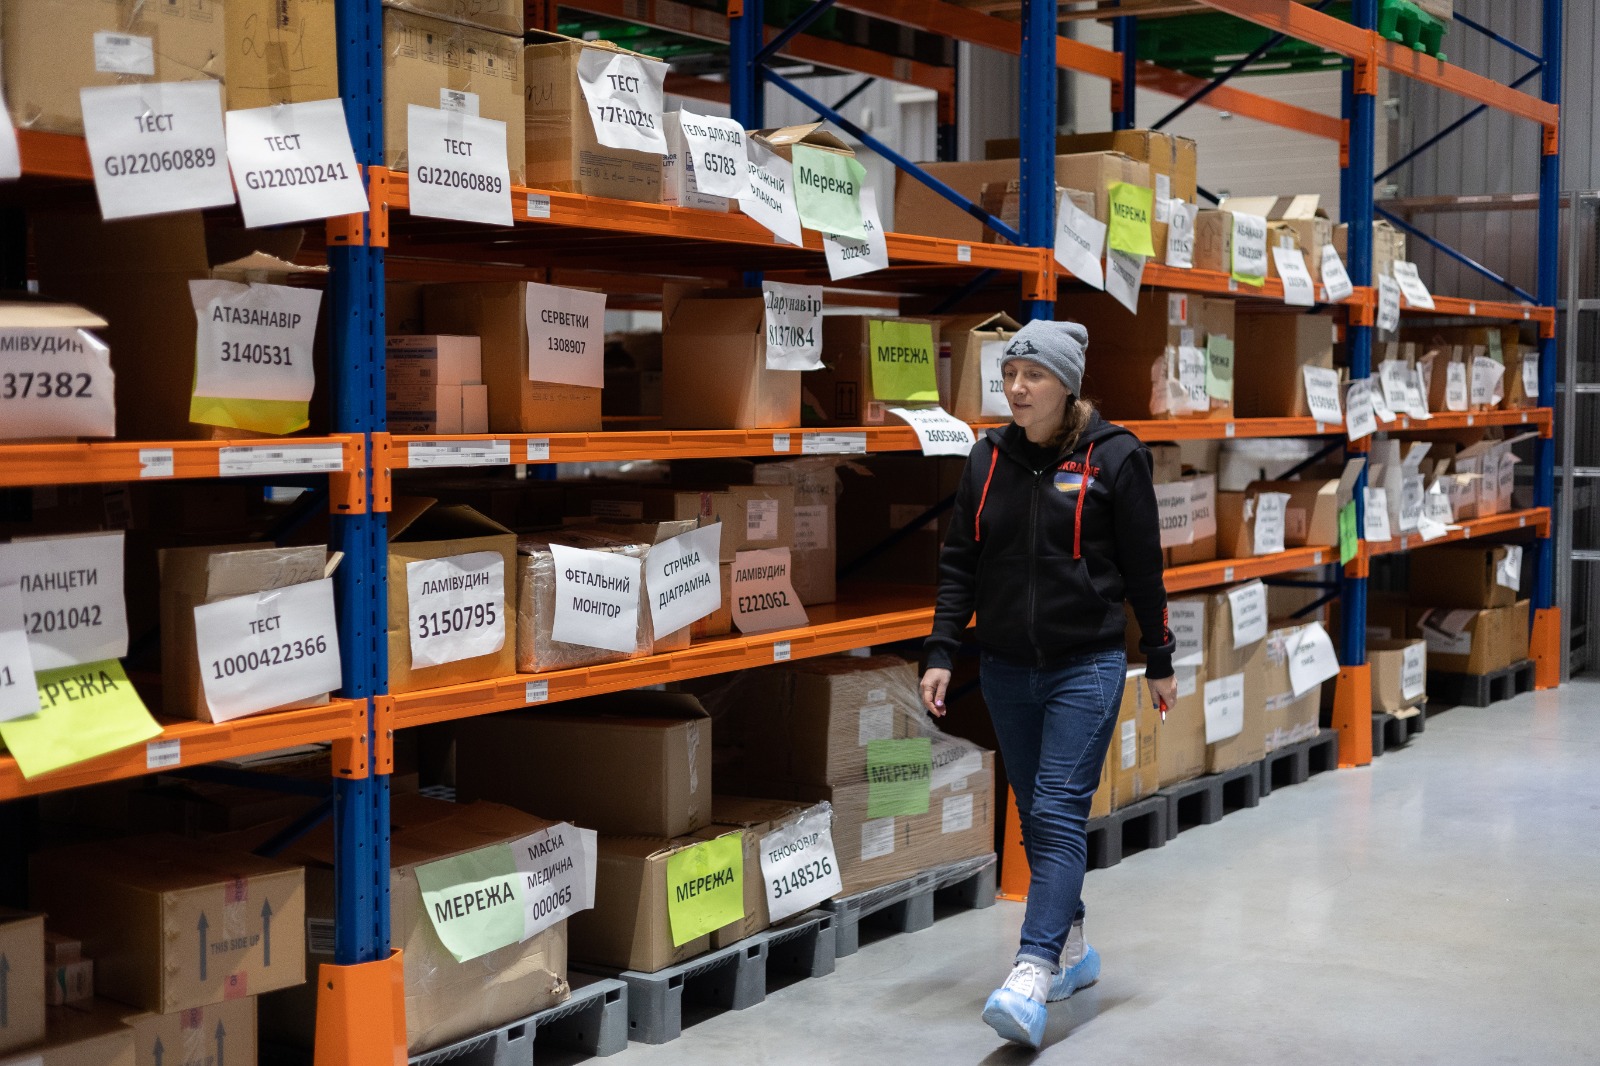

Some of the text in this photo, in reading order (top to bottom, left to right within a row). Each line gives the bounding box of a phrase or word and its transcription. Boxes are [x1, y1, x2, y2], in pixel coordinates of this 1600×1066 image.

[607, 74, 639, 94] ТЕСТ
[134, 114, 174, 134] ТЕСТ
[683, 123, 742, 147] ГЕЛЬ ДЛЯ УЗД
[264, 134, 301, 152] ТЕСТ
[444, 138, 472, 157] ТЕСТ
[104, 147, 217, 177] GJ22060889
[704, 151, 737, 177] G5783
[245, 162, 349, 190] GJ22020241
[417, 166, 502, 194] GJ22060889
[800, 166, 853, 195] Мережа
[1113, 202, 1147, 223] МЕРЕЖА
[841, 244, 871, 261] 2022-05
[766, 290, 822, 317] Дарунавір
[213, 305, 301, 329] АТАЗАНАВІР
[541, 309, 589, 330] СЕРВЕТКИ
[548, 337, 586, 355] 1308907
[769, 325, 815, 347] 8137084
[221, 341, 293, 366] 3140531
[877, 346, 929, 365] МЕРЕЖА
[925, 430, 969, 443] 26053843
[663, 551, 701, 577] СТРІЧКА
[735, 564, 786, 583] ЛАМІВУДИН
[421, 571, 489, 596] ЛАМІВУДИН
[565, 567, 630, 594] ФЕТАЛЬНИЙ
[659, 572, 711, 610] ДІАГРАМНА
[572, 596, 621, 619] МОНІТОР
[738, 590, 790, 614] E222062
[249, 615, 282, 635] ТЕСТ
[418, 602, 496, 639] 3150795
[212, 635, 327, 680] 1000422366
[872, 763, 930, 783] МЕРЕЖА
[527, 834, 565, 861] МАСКА
[768, 832, 819, 864] ТЕНОФОВІР
[527, 856, 574, 889] МЕДИЧНА
[676, 867, 735, 903] МЕРЕЖА
[772, 856, 832, 899] 3148526
[434, 881, 515, 924] МЕРЕЖА
[533, 885, 572, 920] 000065
[211, 934, 260, 955] THIS SIDE UP
